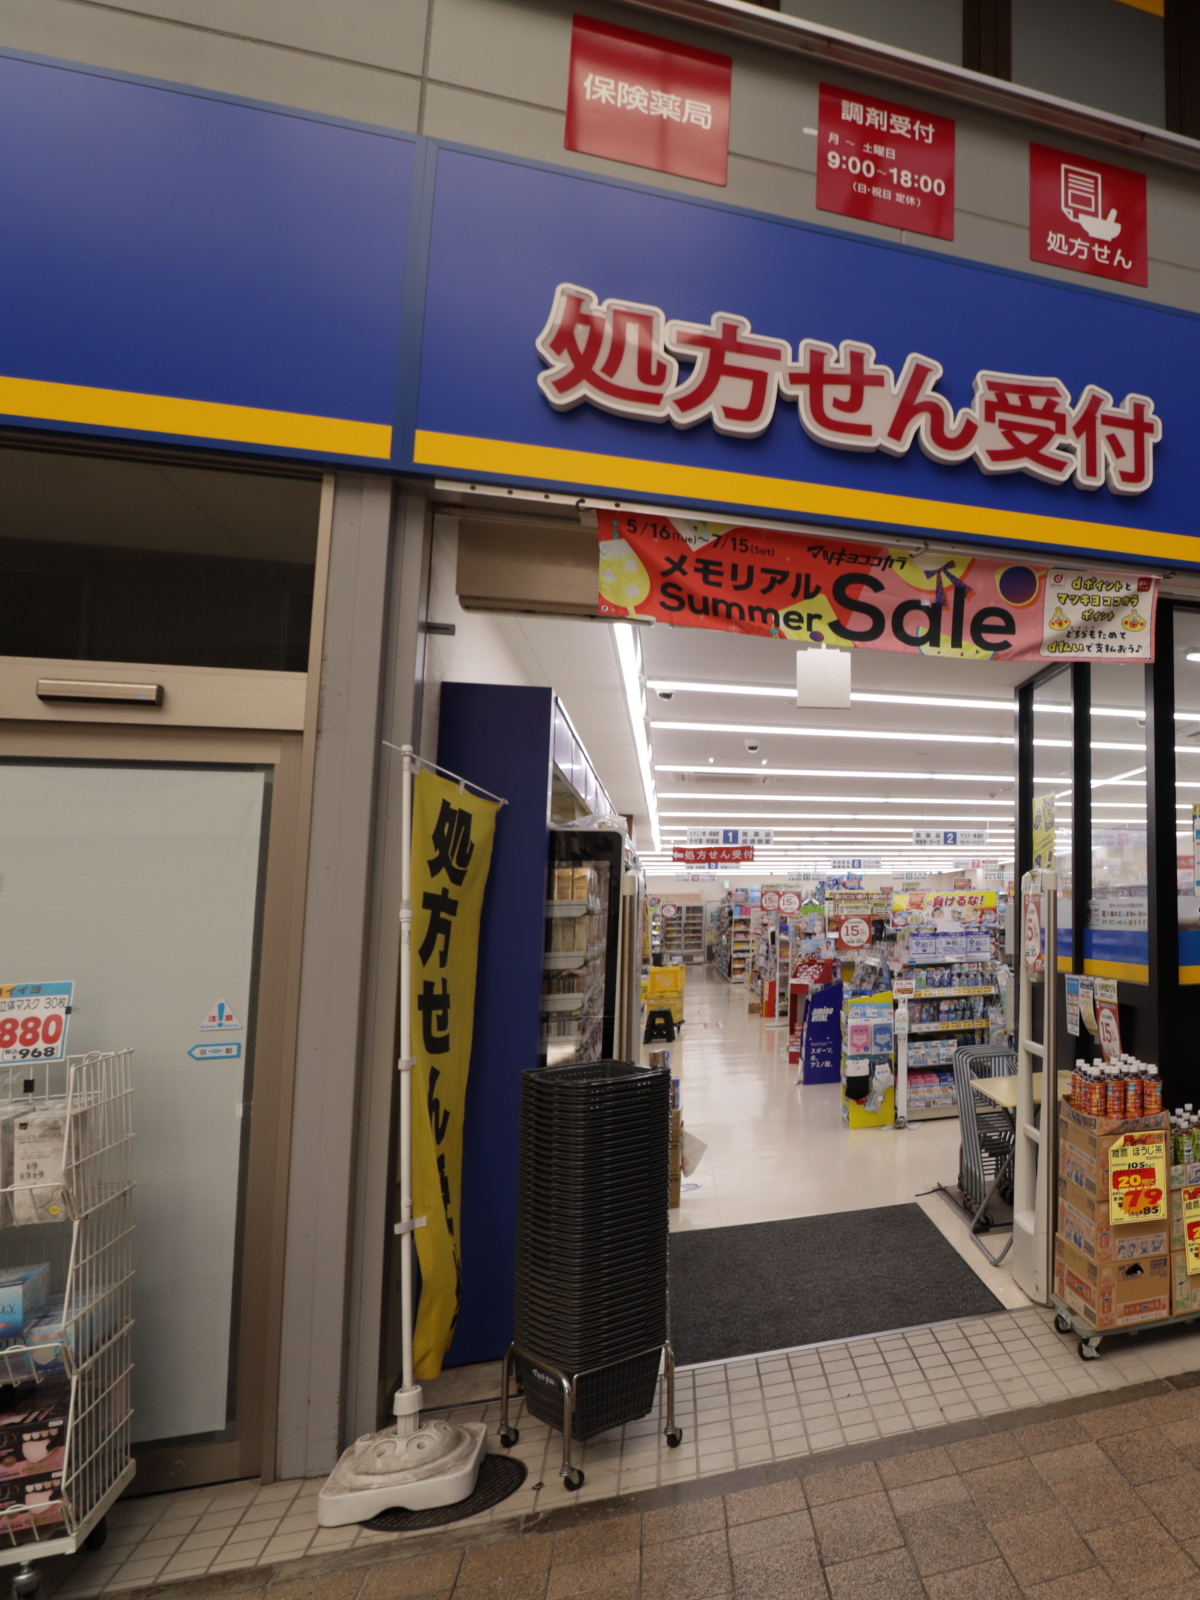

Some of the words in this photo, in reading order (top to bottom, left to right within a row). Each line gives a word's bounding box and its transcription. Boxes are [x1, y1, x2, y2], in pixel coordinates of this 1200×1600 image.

[583, 72, 713, 130] 保険薬局
[841, 99, 936, 145] 調剤受付
[828, 131, 839, 145] 月
[862, 142, 896, 160] 土曜日
[1046, 229, 1134, 270] 処方せん
[538, 285, 1160, 492] 処方せん受付
[806, 545, 908, 572] マツキヨココカラ
[659, 554, 822, 602] メモリアル
[1071, 576, 1132, 592] dポイントと
[1056, 592, 1140, 607] マツキヨココカラ
[658, 581, 823, 634] Summer
[828, 572, 1017, 652] Sale
[1081, 608, 1115, 622] ポイント
[1066, 630, 1127, 640] どちらもためて
[946, 833, 954, 844] 2
[684, 850, 755, 861] 処方せん受付
[844, 925, 860, 937] 15
[0, 998, 40, 1012] 立体マスク
[44, 996, 67, 1010] 30枚
[811, 1006, 834, 1016] amino
[208, 1014, 234, 1023] 注意
[811, 1014, 829, 1022] VITAL
[0, 1014, 63, 1049] 880
[1101, 1021, 1112, 1044] 15
[416, 798, 476, 1298] 処方せん
[1129, 1137, 1147, 1147] Sale
[1132, 1145, 1163, 1157] ほうじ茶
[1123, 1187, 1163, 1208] 79
